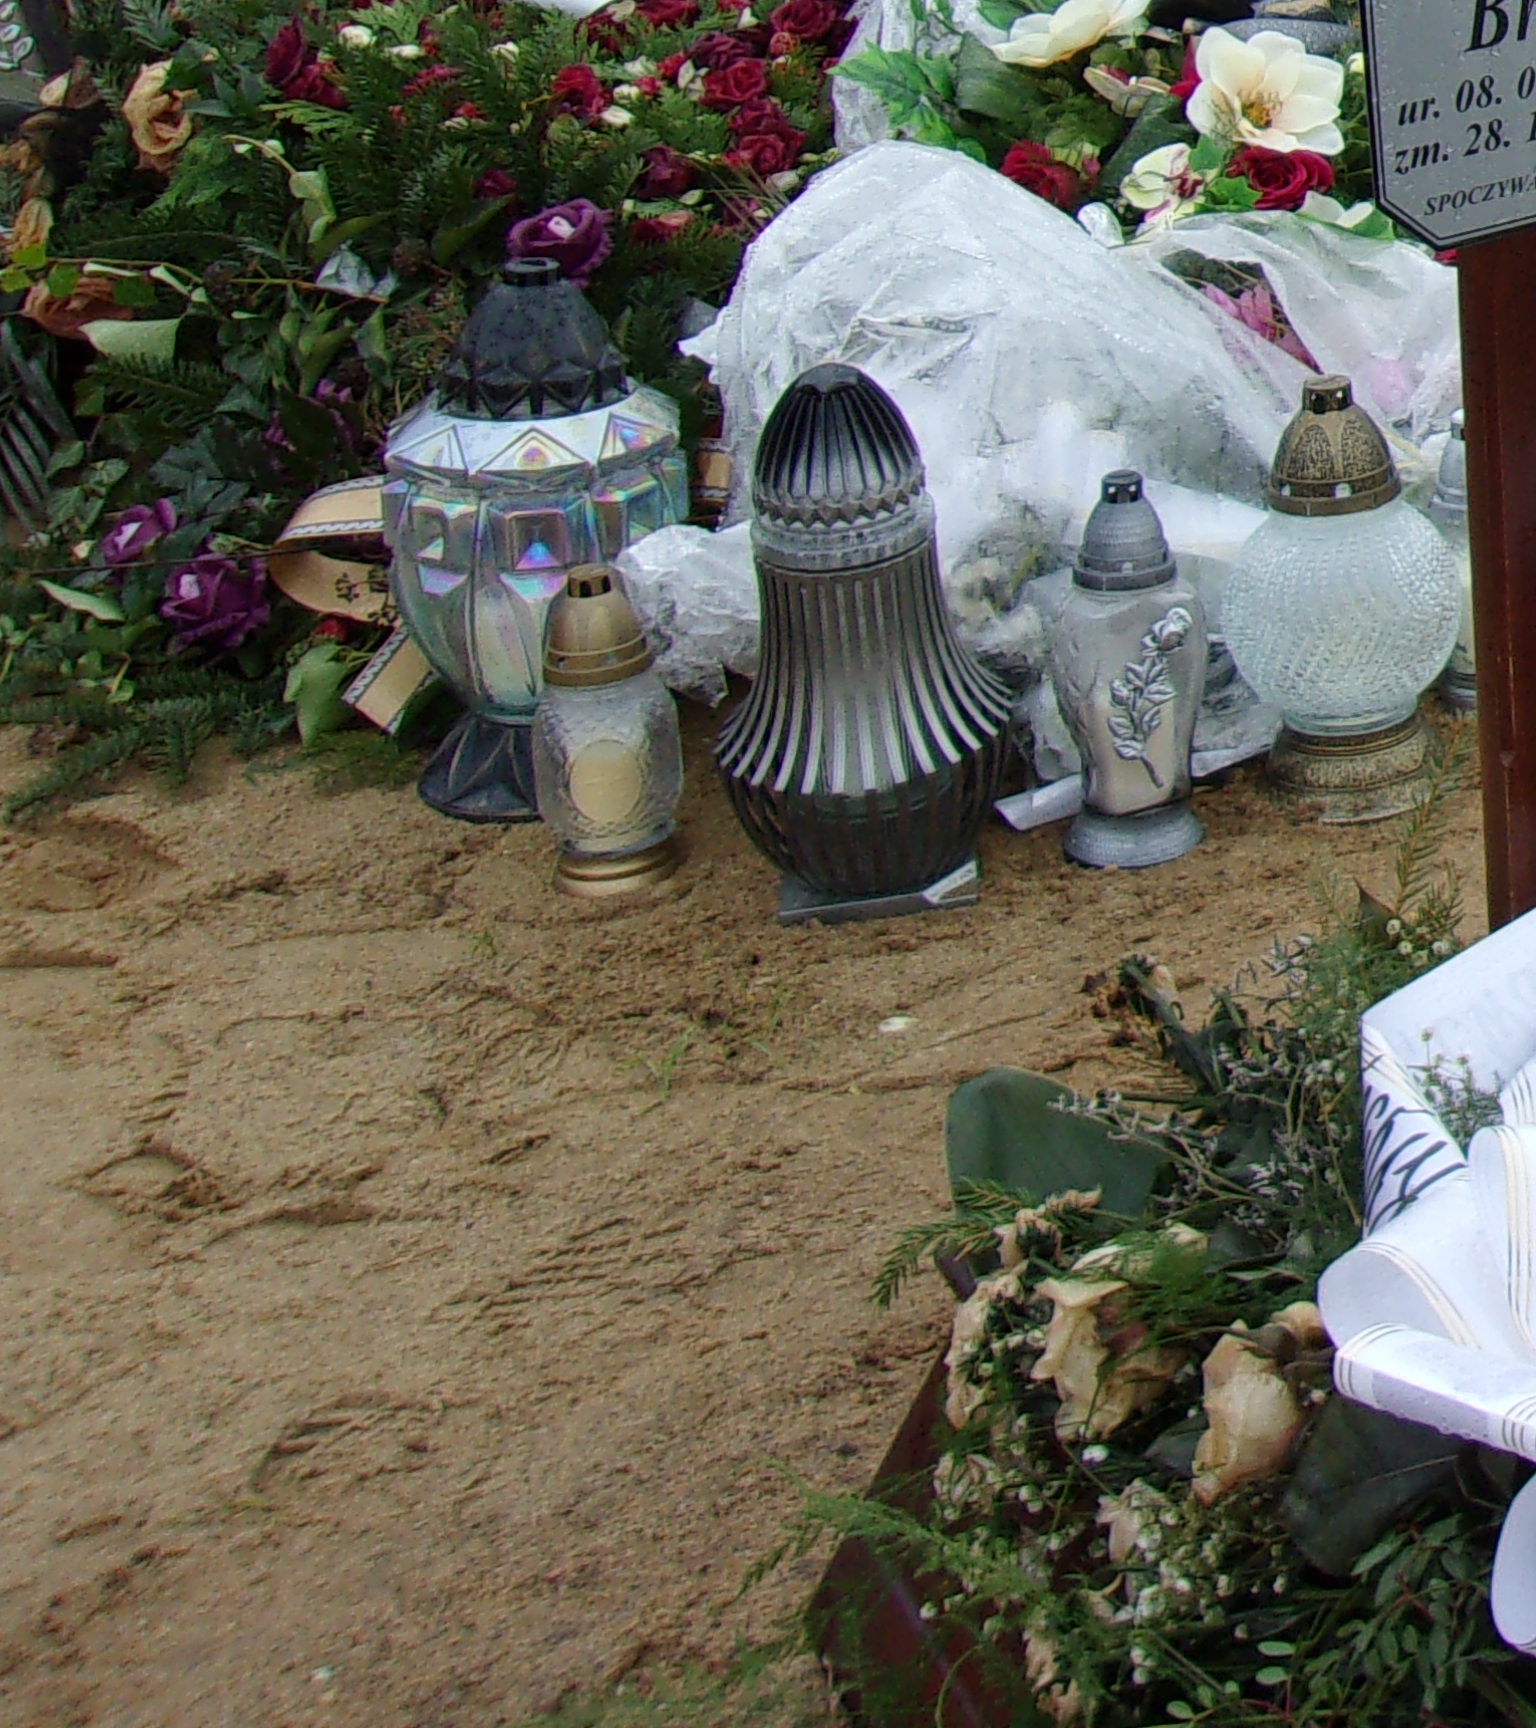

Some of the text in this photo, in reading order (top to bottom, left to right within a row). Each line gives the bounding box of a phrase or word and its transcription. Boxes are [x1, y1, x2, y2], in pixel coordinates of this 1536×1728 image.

[1397, 95, 1441, 126] ur.
[1455, 75, 1502, 113] 08.
[1394, 141, 1450, 176] zm.
[1462, 118, 1511, 158] 28.
